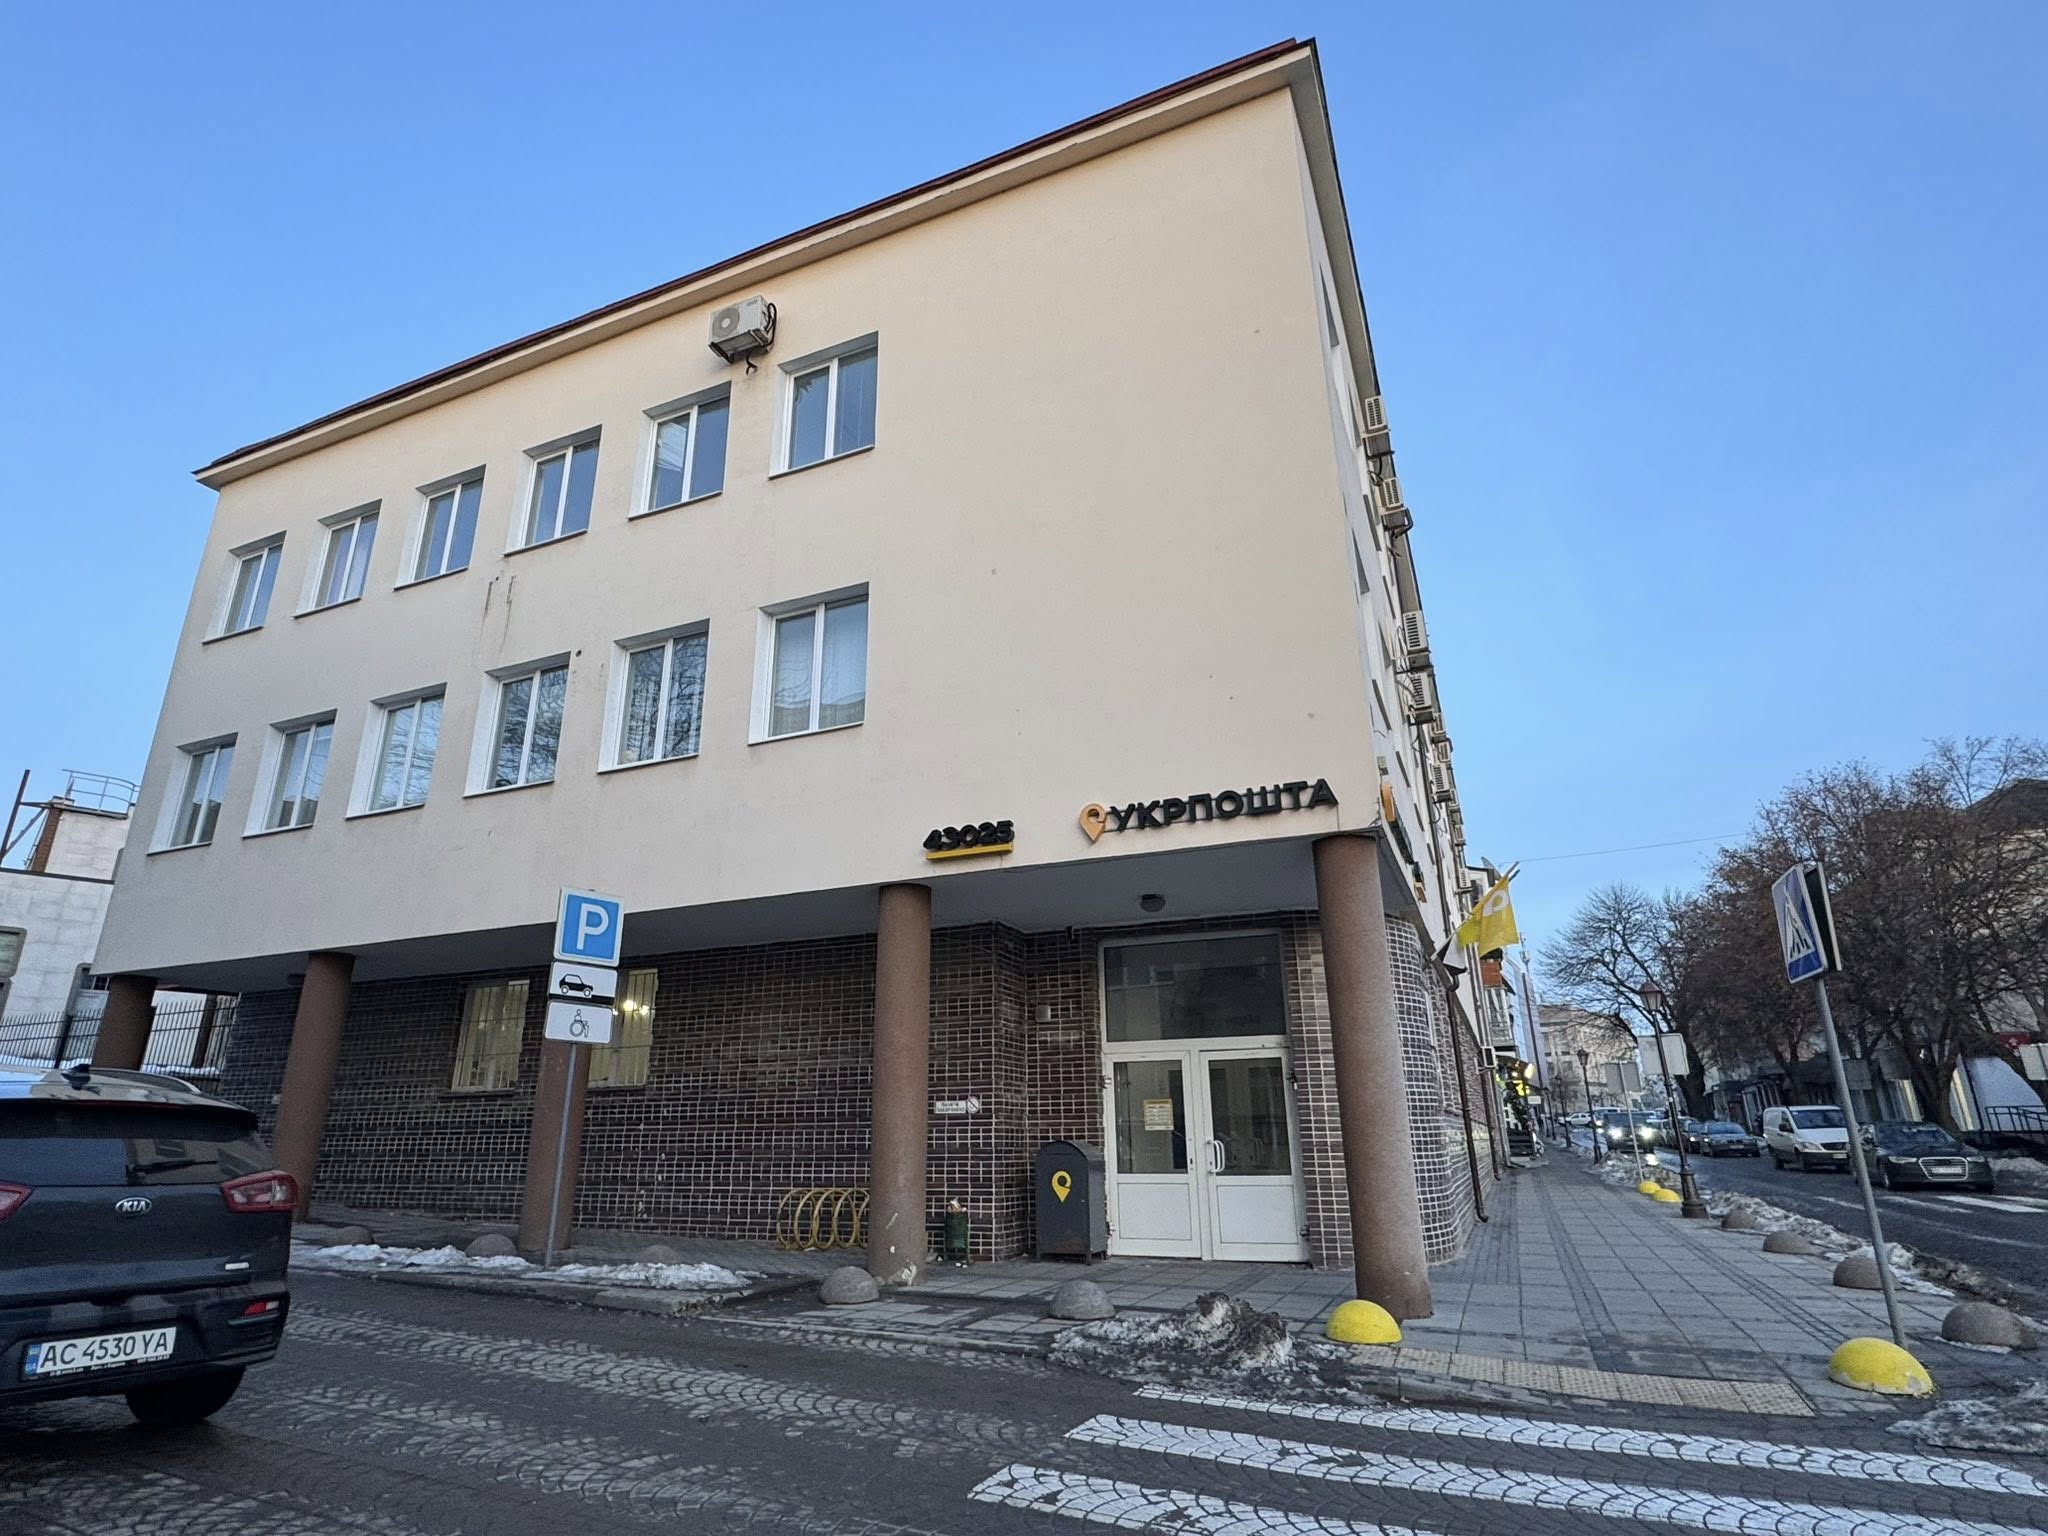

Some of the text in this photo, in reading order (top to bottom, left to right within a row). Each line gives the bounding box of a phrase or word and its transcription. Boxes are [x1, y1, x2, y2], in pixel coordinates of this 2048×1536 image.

[1110, 778, 1339, 832] УКРПОШТА
[923, 820, 1015, 850] 43025
[576, 902, 609, 951] P
[122, 1200, 147, 1212] KIA
[40, 1332, 168, 1369] AC 4530 YA
